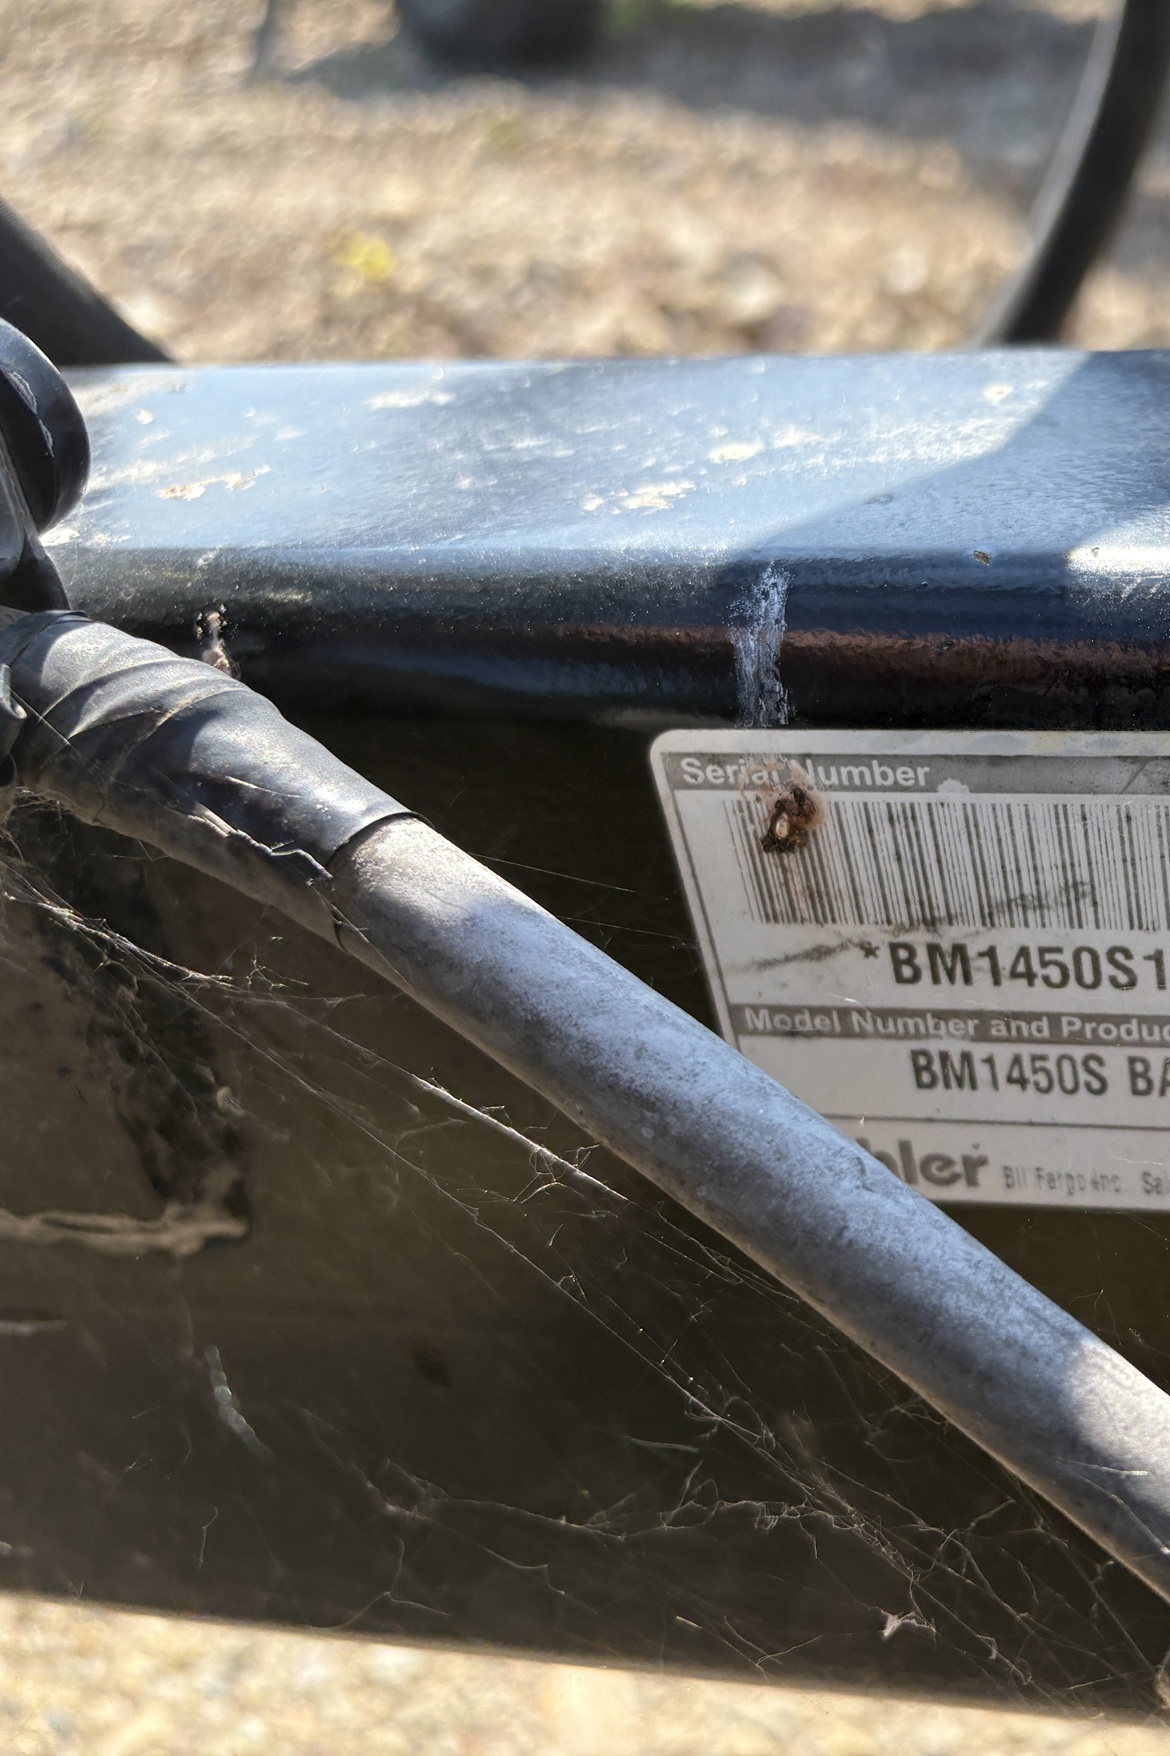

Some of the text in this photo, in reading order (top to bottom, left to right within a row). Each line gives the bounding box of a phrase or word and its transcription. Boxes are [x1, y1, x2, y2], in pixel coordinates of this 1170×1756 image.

[680, 757, 930, 787] Serial Number
[744, 1008, 840, 1033] Model
[852, 1010, 978, 1037] Number
[989, 1015, 1050, 1038] and
[910, 1048, 1108, 1096] BM1450S
